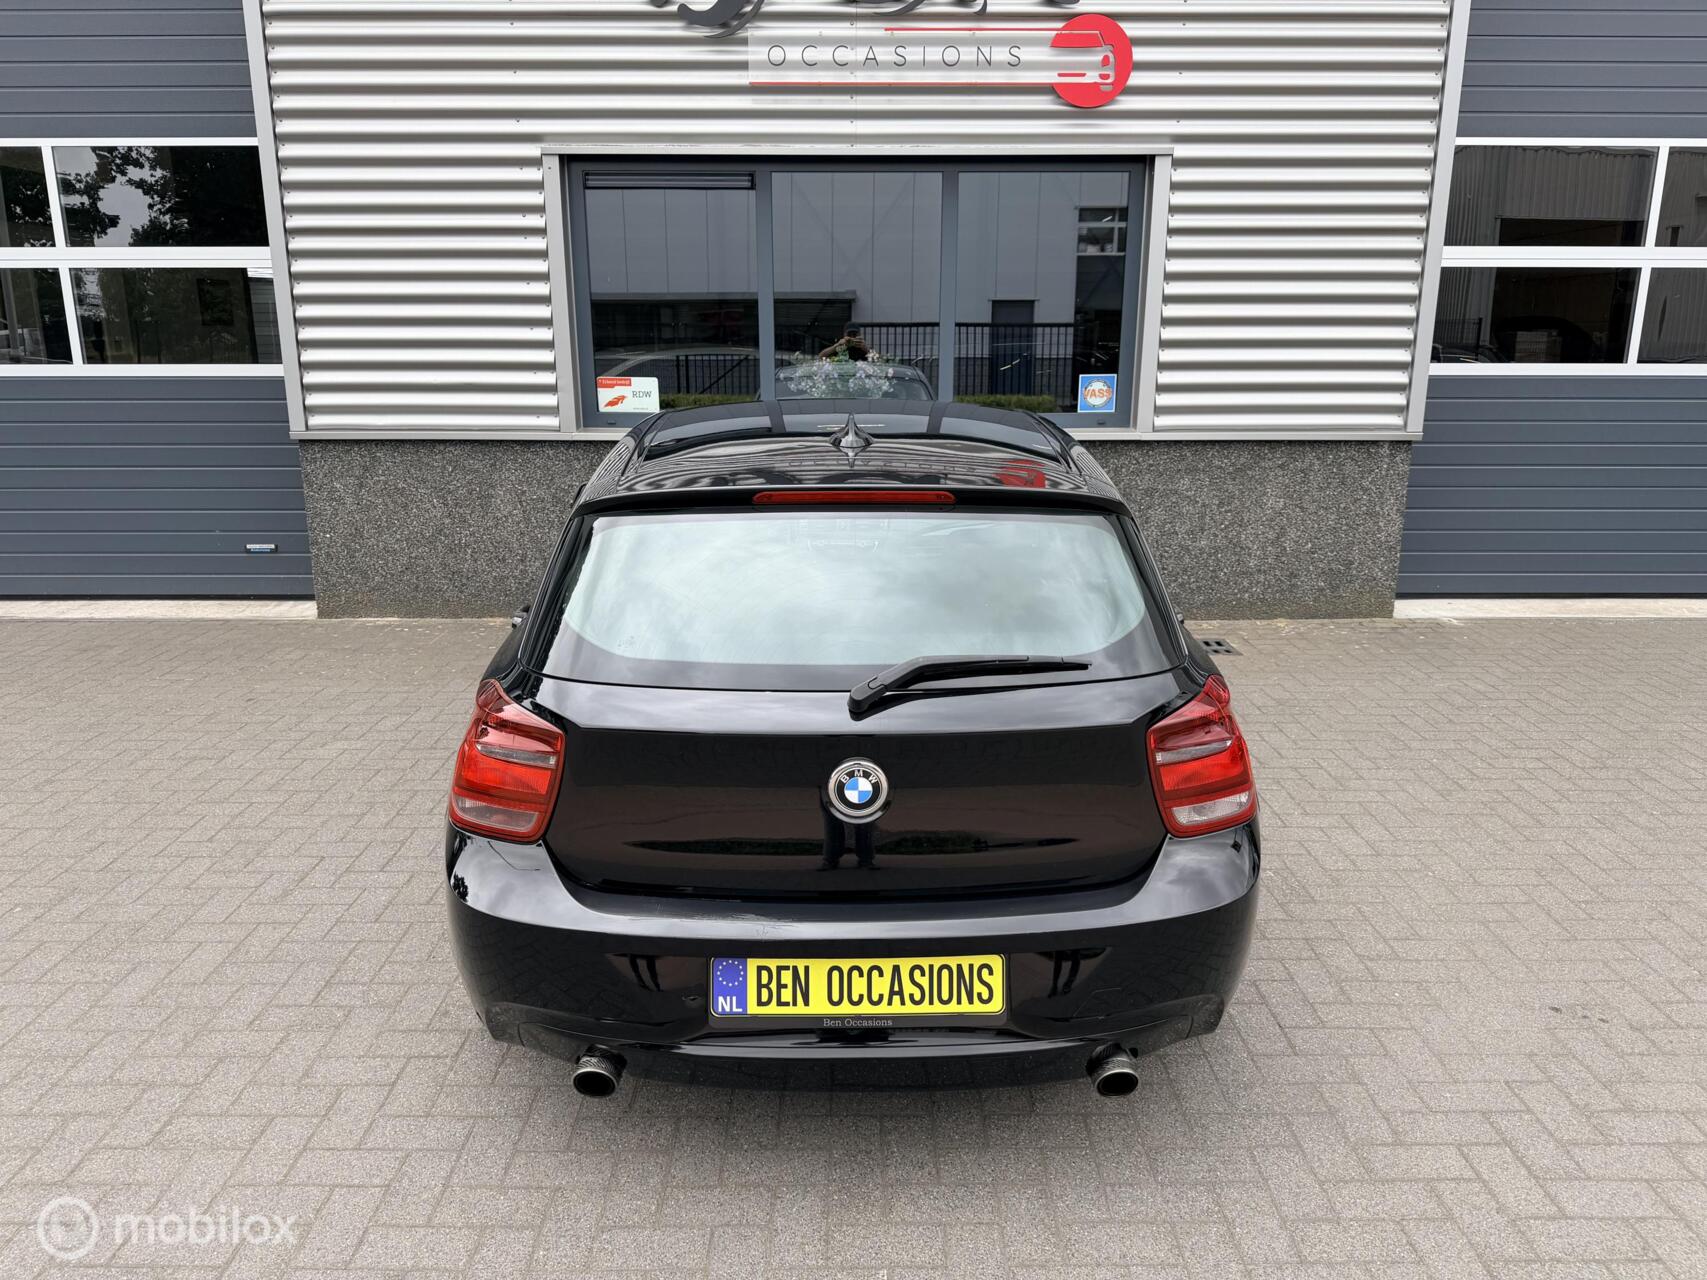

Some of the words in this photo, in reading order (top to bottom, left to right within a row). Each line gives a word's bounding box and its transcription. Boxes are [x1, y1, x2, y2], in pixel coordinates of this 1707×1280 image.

[767, 44, 1024, 68] OCCASIONS
[632, 390, 652, 398] RDW
[840, 769, 878, 784] BMW
[756, 964, 810, 1007] BEN
[827, 962, 994, 1006] OCCASIONS
[718, 996, 743, 1013] NL
[823, 1018, 842, 1027] Ben
[844, 1018, 893, 1027] Occasions
